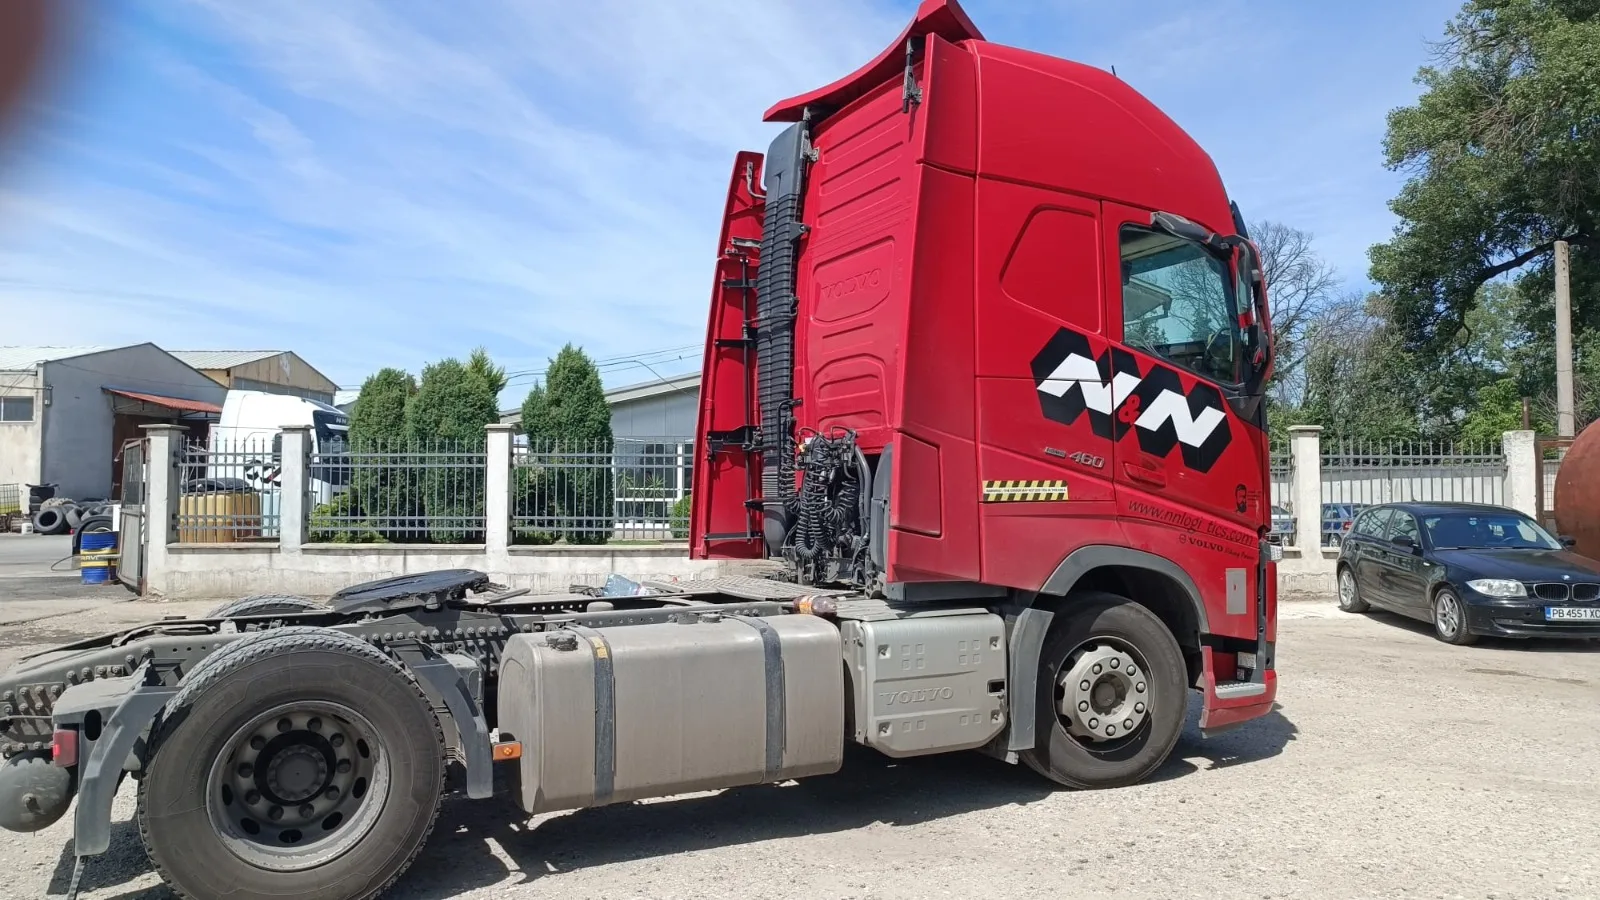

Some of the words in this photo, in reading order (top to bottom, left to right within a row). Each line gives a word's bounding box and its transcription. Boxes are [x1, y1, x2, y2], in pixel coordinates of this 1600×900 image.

[821, 267, 882, 298] VOLVO
[1069, 451, 1105, 468] 460
[1188, 537, 1224, 552] VOLVO
[1552, 608, 1565, 618] PB
[1566, 608, 1587, 618] 4551
[880, 686, 954, 706] VOLVO
